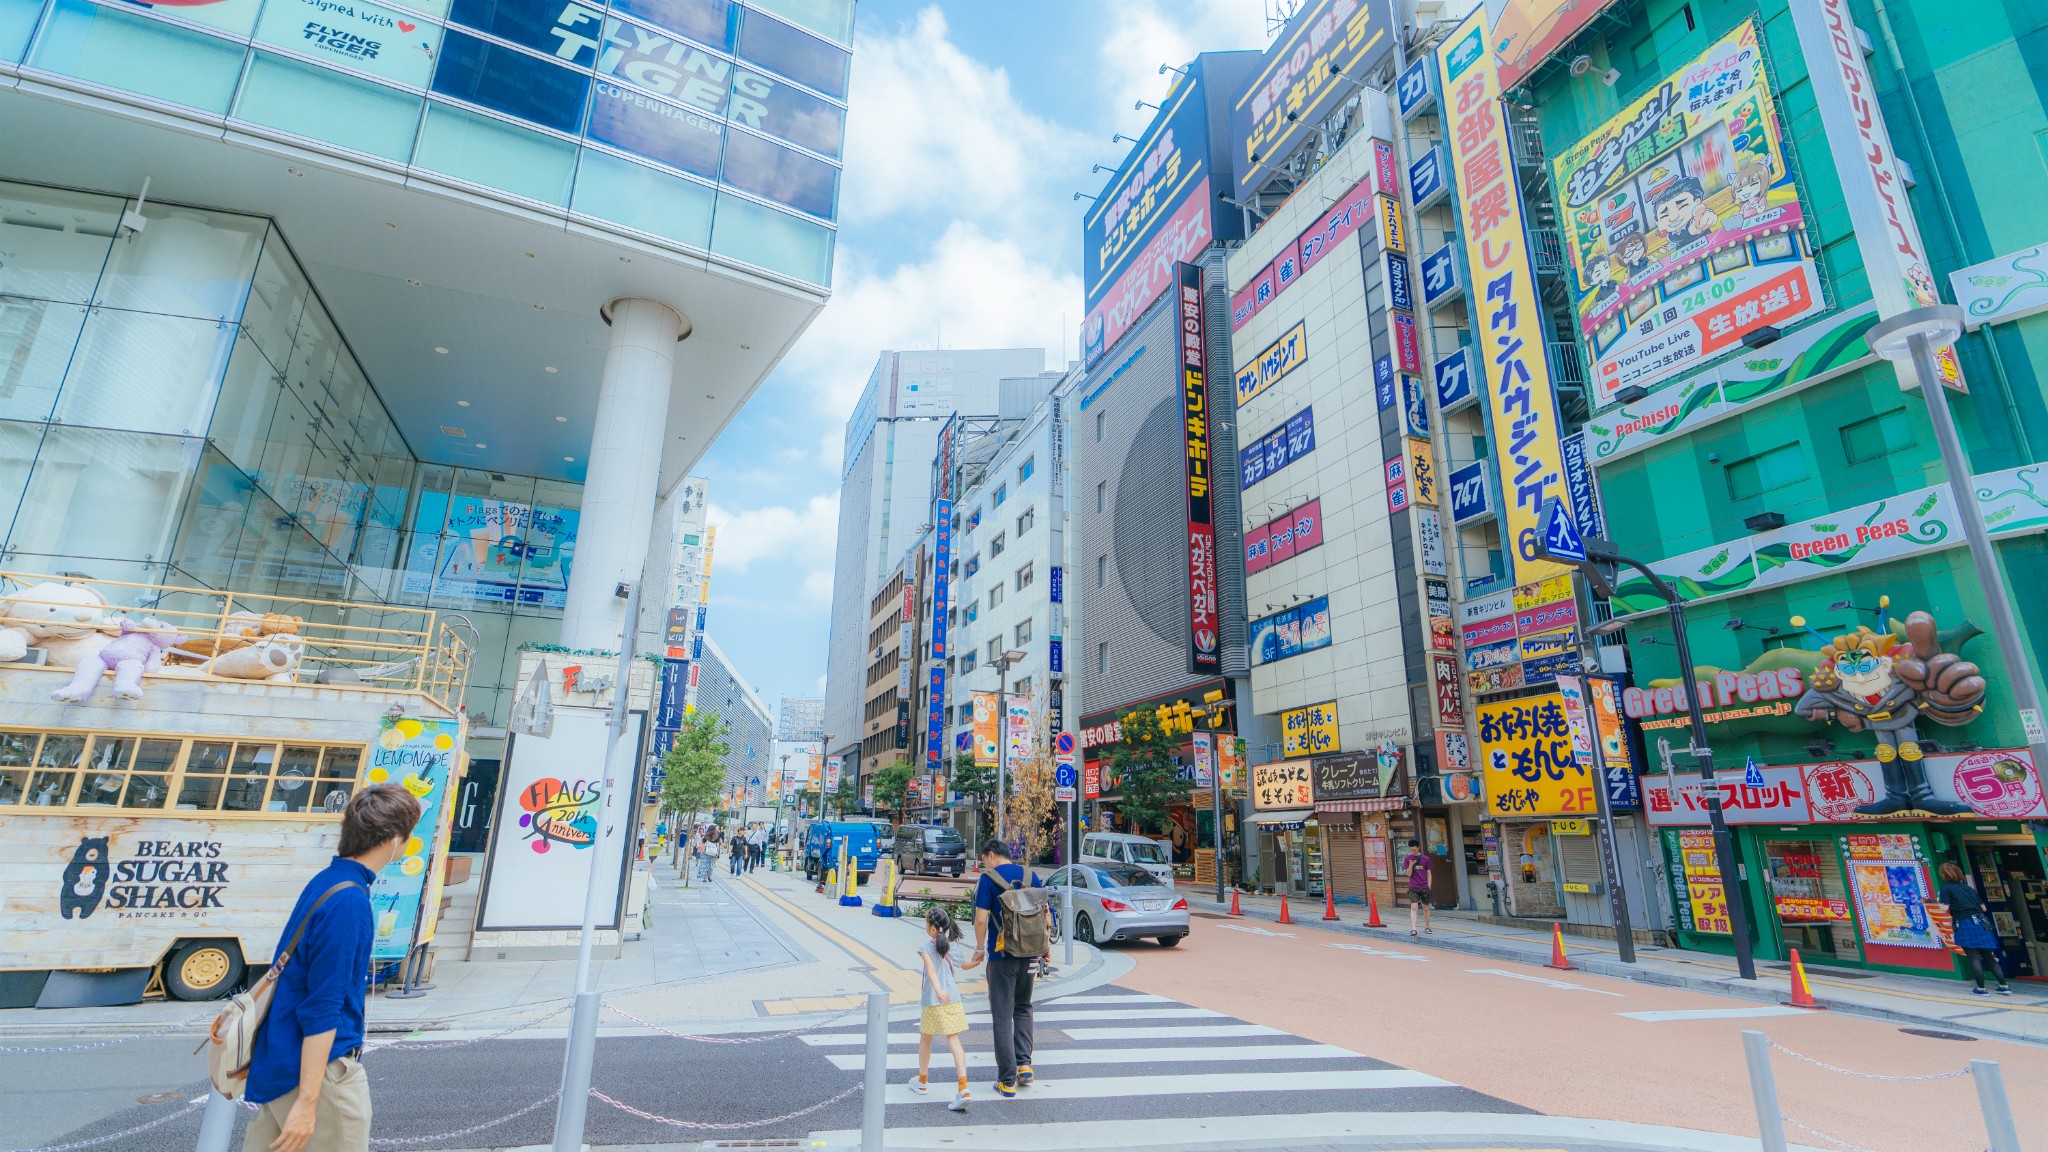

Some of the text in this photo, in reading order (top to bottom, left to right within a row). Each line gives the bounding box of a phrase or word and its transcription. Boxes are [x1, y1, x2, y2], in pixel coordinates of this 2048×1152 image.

[306, 22, 382, 50] FLYING
[361, 11, 394, 28] with
[303, 29, 379, 59] TIGER
[314, 43, 364, 61] COPENHAGEN
[557, 3, 775, 99] FLYING
[550, 27, 769, 129] TIGER
[596, 83, 723, 135] COPENHAGEN
[1566, 129, 1611, 165] Green Peas
[1614, 224, 1635, 240] BAR
[1256, 258, 1295, 306] 麻雀
[1455, 72, 1513, 270] お部屋探し
[1486, 269, 1559, 515] タウンハウジング
[1617, 328, 1691, 370] YouTube Live
[1621, 344, 1697, 385] ニコニコ生放送
[1615, 403, 1680, 439] Pachislo
[1244, 427, 1312, 484] カラオケ 747
[1387, 459, 1405, 507] 麻雀
[1452, 474, 1482, 511] 747
[1247, 539, 1268, 561] 麻雀
[1789, 516, 1911, 561] Green Peas
[1466, 598, 1506, 618] 新宿キリンビル
[1535, 605, 1575, 626] ダンディ
[1265, 647, 1276, 660] 3F
[562, 665, 613, 706] Flags
[665, 663, 679, 727] GAP
[1436, 661, 1455, 715] 肉バル
[1622, 667, 1806, 719] Green Peas
[374, 749, 450, 768] LEMONADE
[1321, 760, 1358, 780] クレープ
[530, 779, 601, 809] FLAGS
[1321, 777, 1380, 791] 牛乳ソフトクリーム
[1559, 786, 1593, 812] 2F
[135, 840, 223, 858] BEAR'S
[113, 860, 230, 884] SUGAR
[1671, 863, 1687, 899] Green
[105, 885, 227, 909] SHACK
[1678, 900, 1693, 931] Peas
